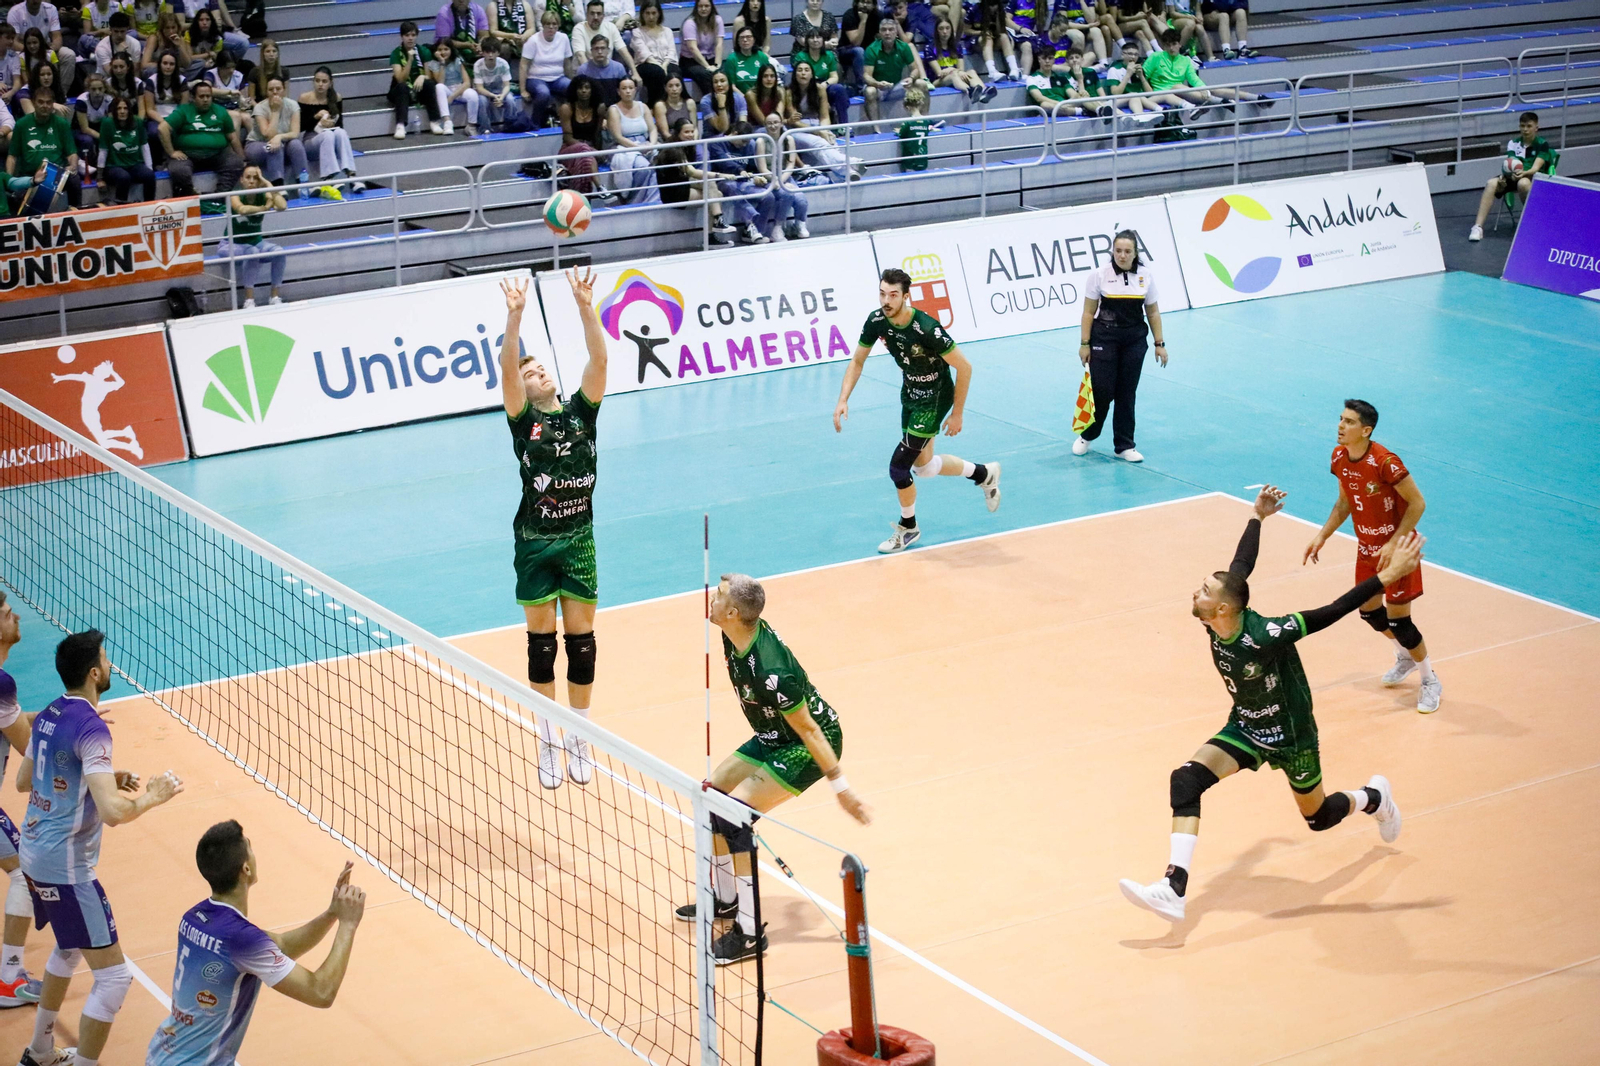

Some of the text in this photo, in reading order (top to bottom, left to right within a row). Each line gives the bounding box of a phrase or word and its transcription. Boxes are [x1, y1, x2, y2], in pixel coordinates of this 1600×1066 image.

[915, 131, 925, 145] 7
[0, 244, 134, 290] UNION
[986, 223, 1154, 285] ALMERA
[698, 288, 839, 328] COSTA DE
[990, 283, 1078, 315] CIUDAD
[677, 318, 851, 379] ALMERÍA
[553, 441, 572, 457] 12
[1353, 495, 1364, 511] 5
[1358, 524, 1394, 535] Unicaja
[36, 739, 47, 780] 6
[174, 944, 190, 992] 5
